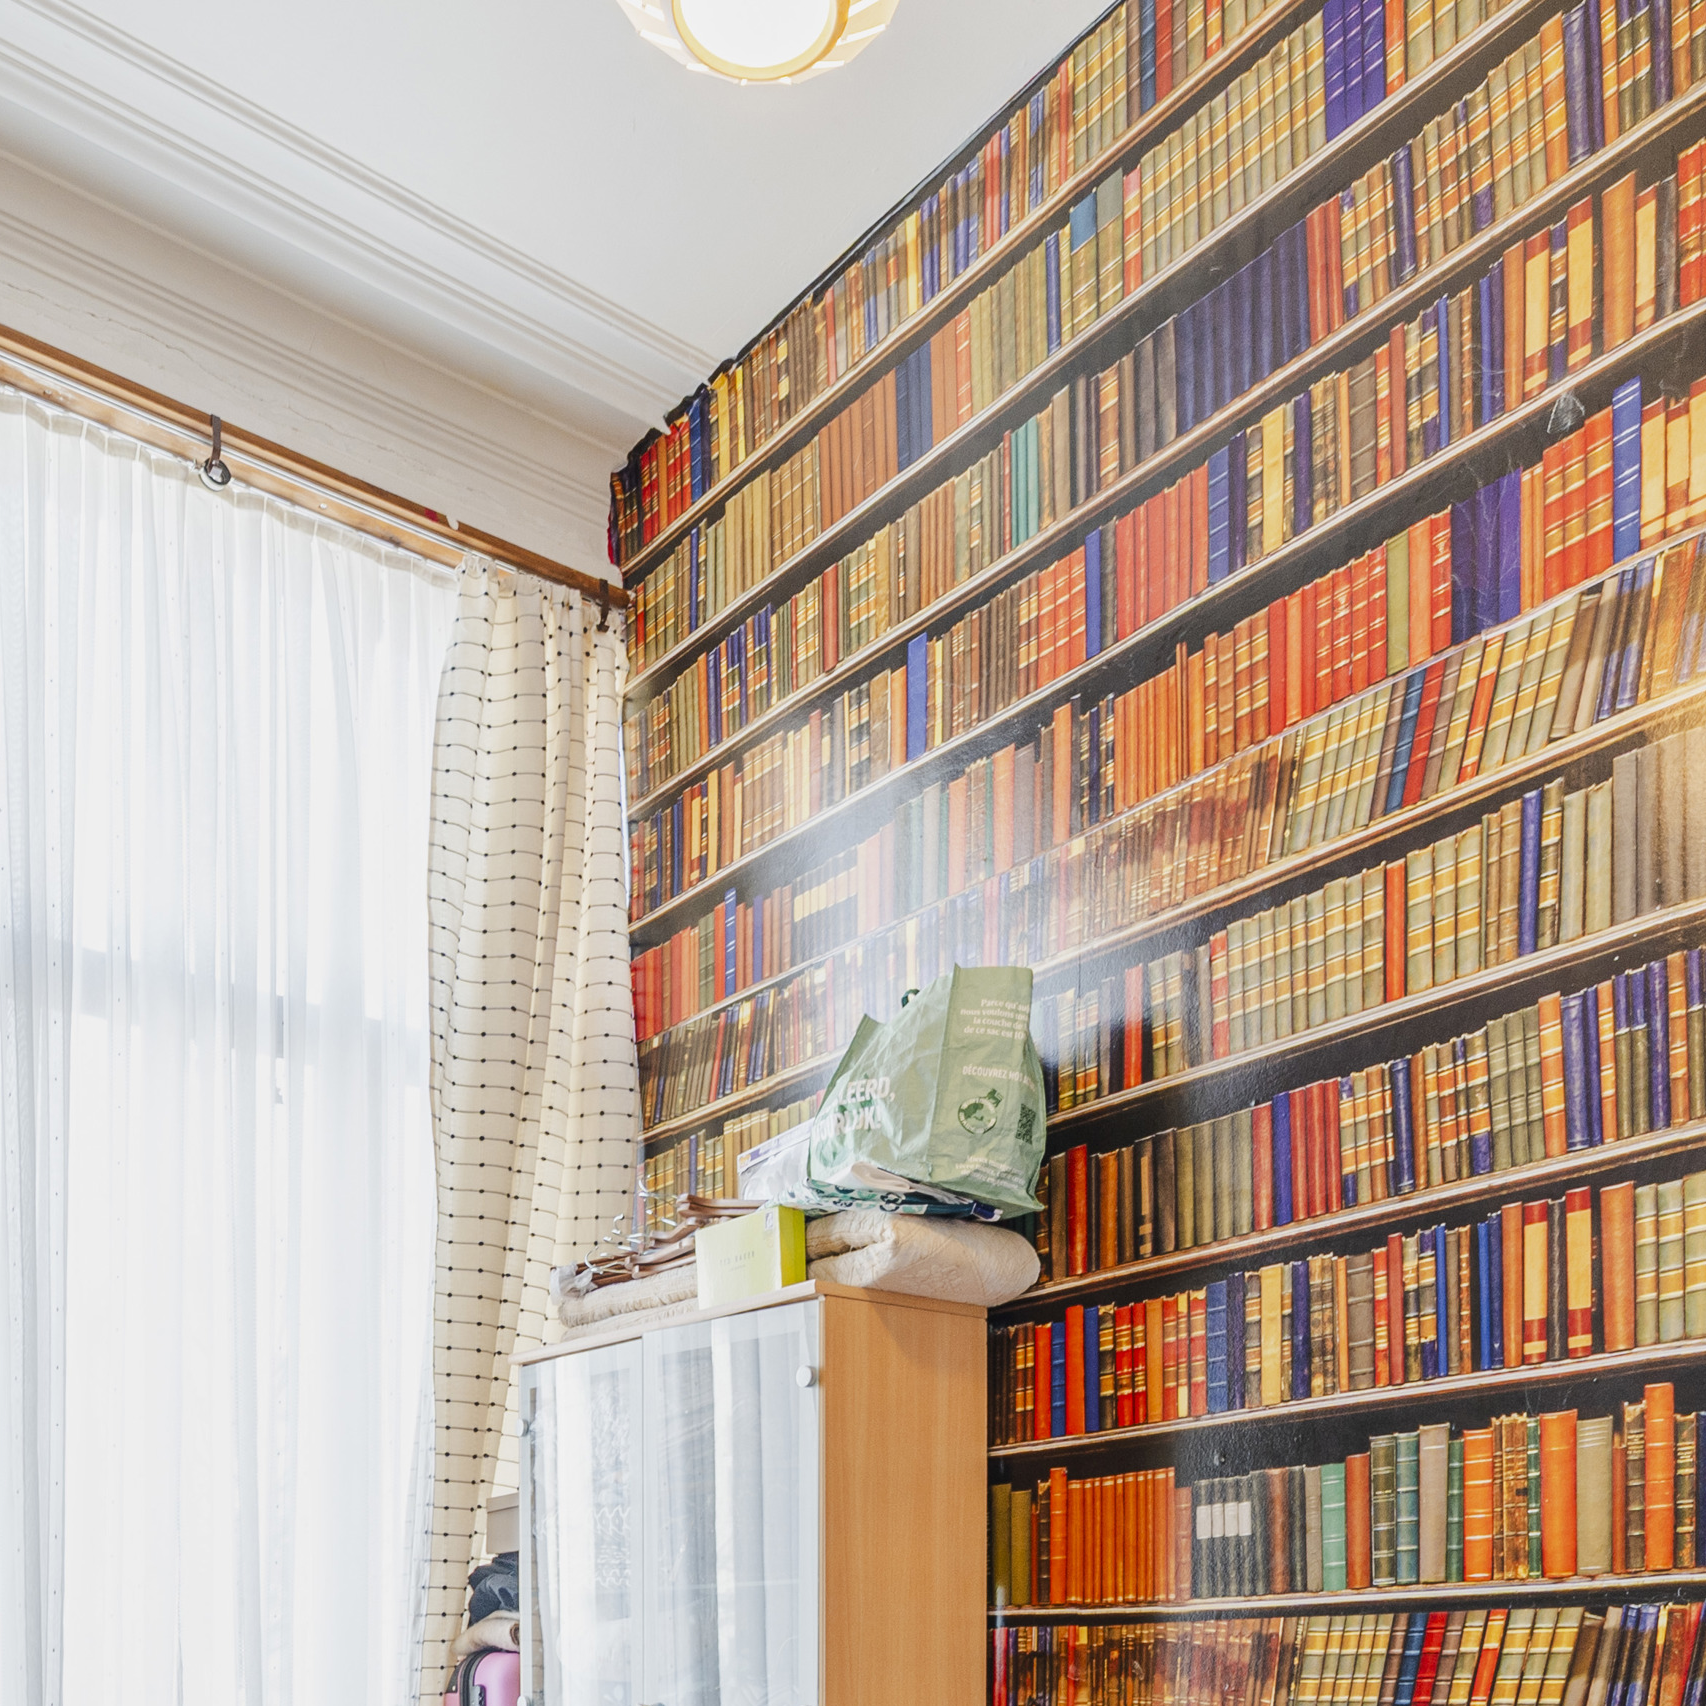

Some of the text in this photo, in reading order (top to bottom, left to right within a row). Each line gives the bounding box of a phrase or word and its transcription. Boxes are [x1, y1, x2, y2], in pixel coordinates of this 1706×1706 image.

[980, 999, 1004, 1008] Parce
[960, 1008, 981, 1016] nous
[982, 1008, 1014, 1019] voulons
[973, 1016, 981, 1025] la
[982, 1018, 1012, 1028] couche
[963, 1025, 974, 1034] de
[976, 1026, 985, 1034] ce
[986, 1027, 999, 1036] sac
[962, 1064, 1008, 1080] DÉCOUVREZ
